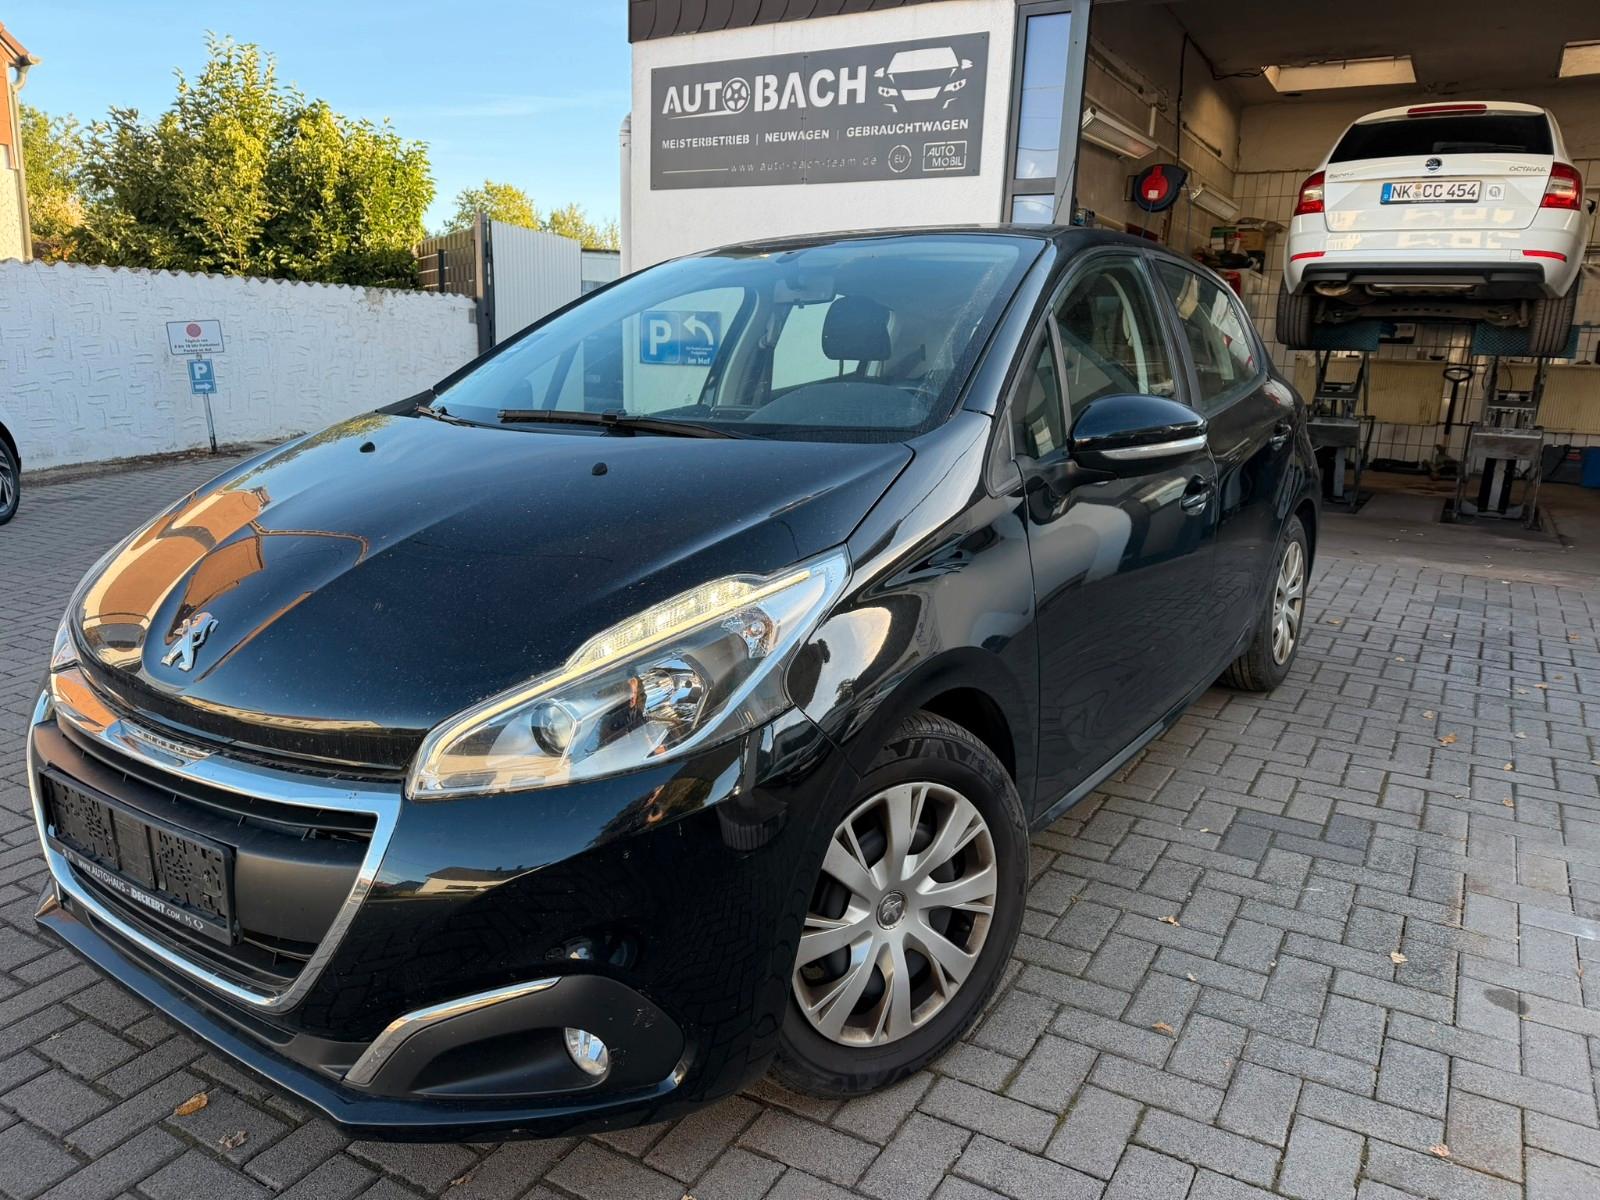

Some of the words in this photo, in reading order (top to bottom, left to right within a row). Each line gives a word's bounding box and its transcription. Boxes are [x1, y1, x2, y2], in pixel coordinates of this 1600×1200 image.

[662, 134, 750, 149] MEISTERBETRIEB
[764, 129, 830, 143] NEUWAGEN
[846, 119, 969, 137] GEBRAUCHTWAGEN
[927, 145, 955, 157] AUTO
[894, 154, 906, 164] EU
[931, 156, 963, 167] MOBIL
[1391, 186, 1413, 198] NK
[1422, 184, 1443, 198] CC
[1446, 184, 1477, 197] 454
[648, 319, 672, 356] P
[193, 363, 208, 379] P
